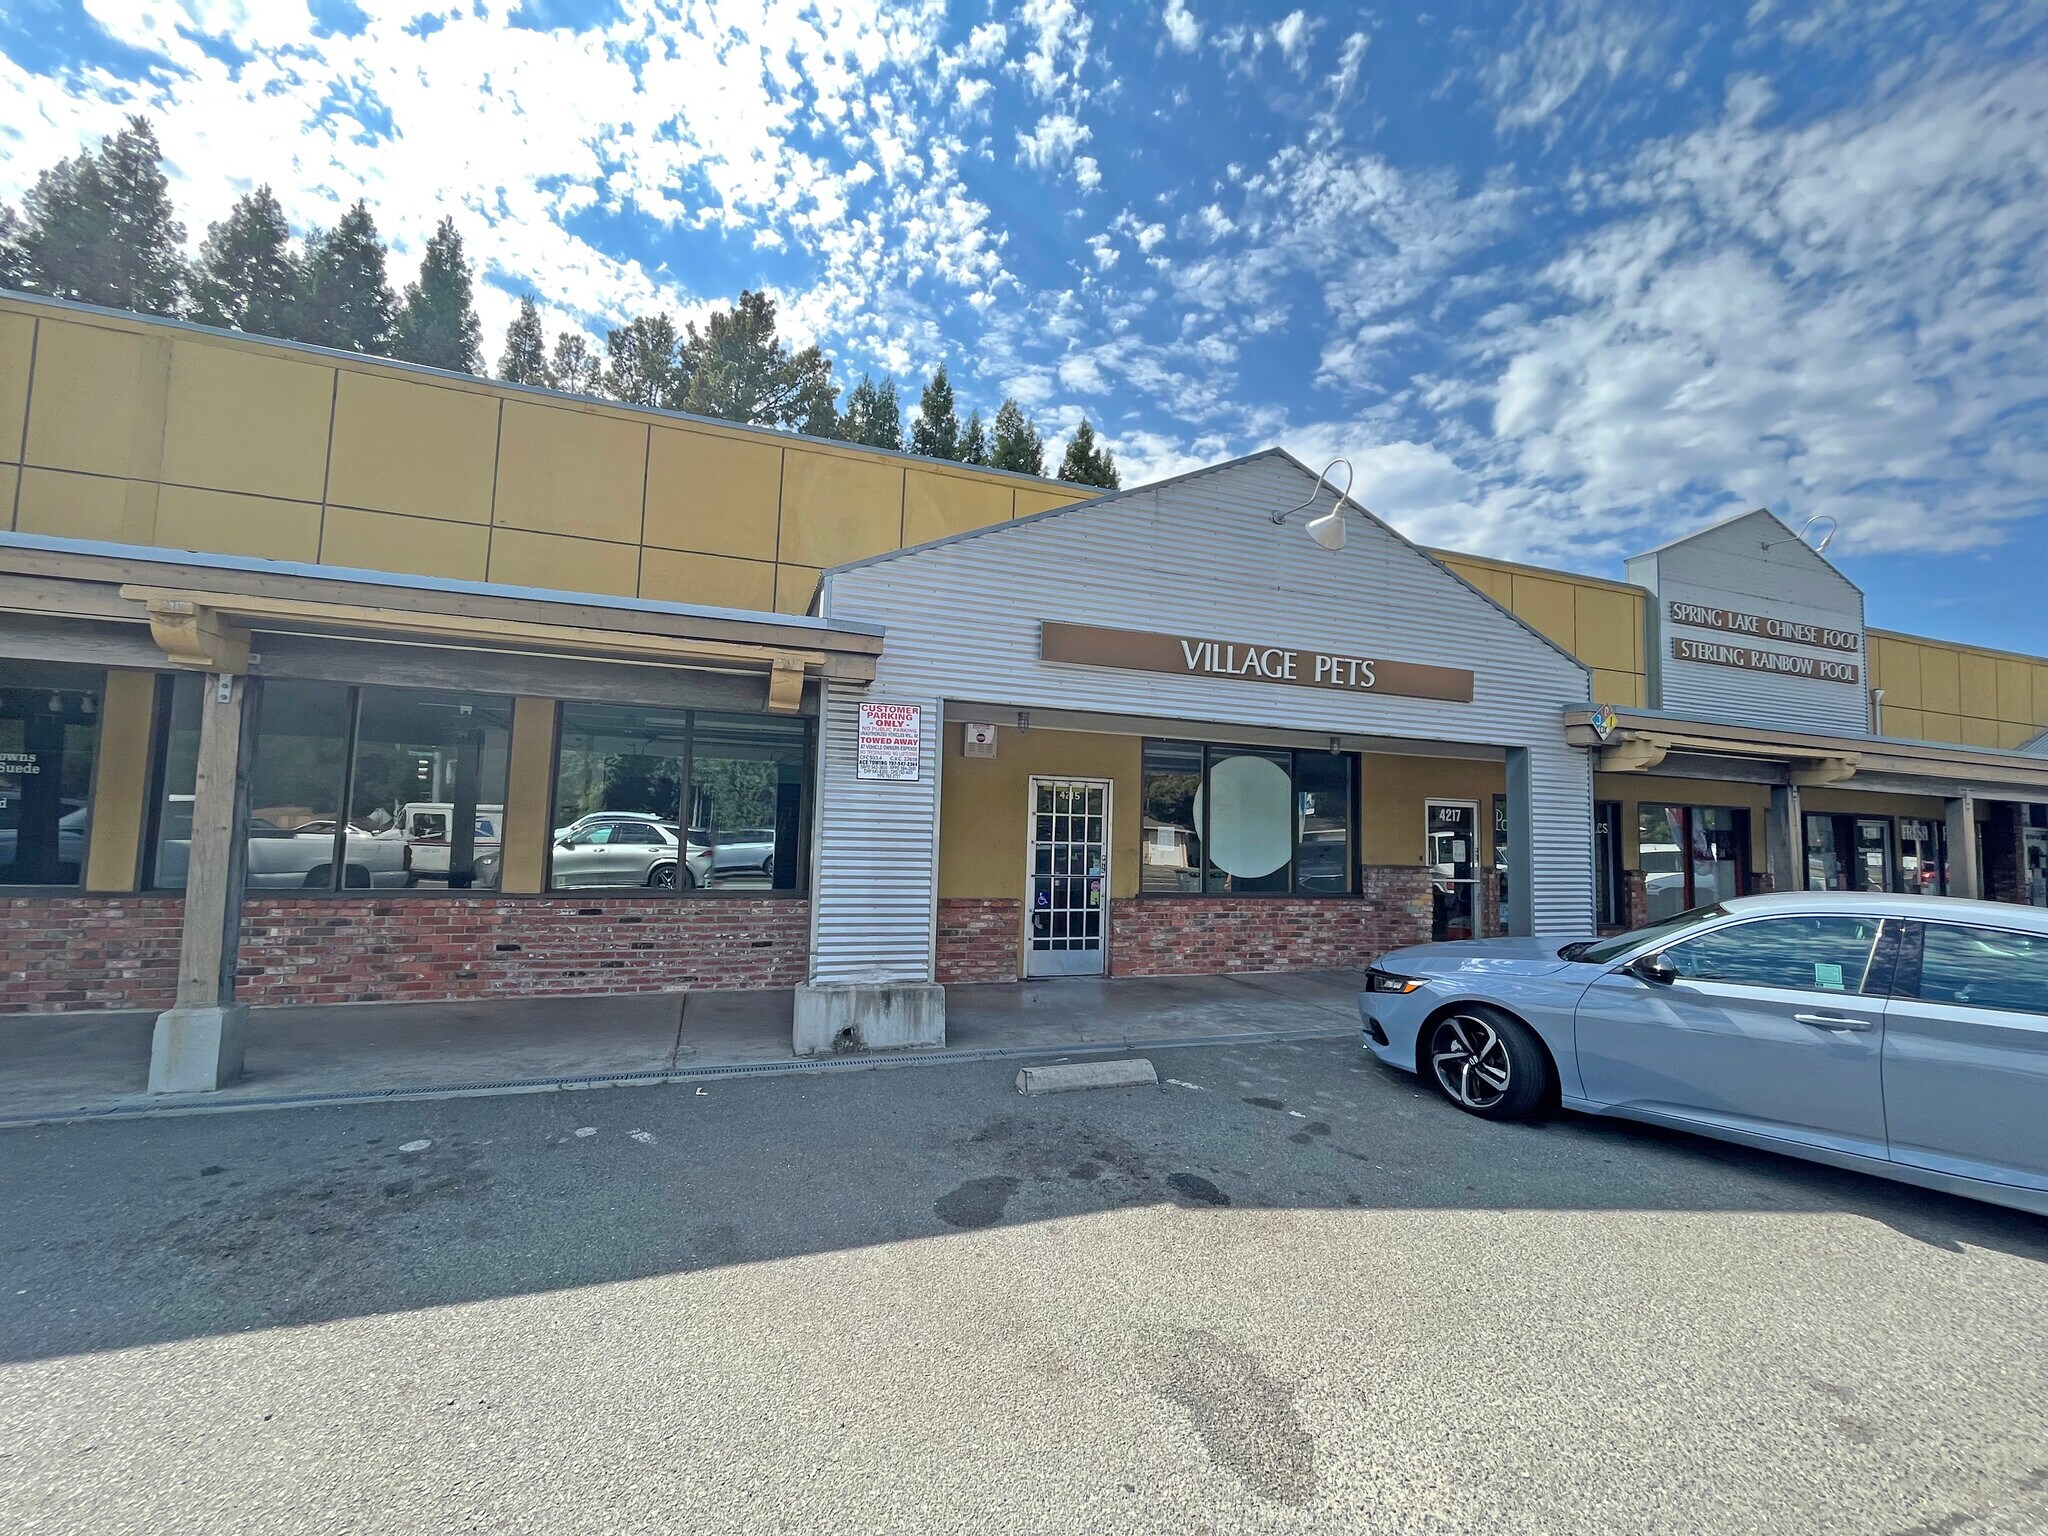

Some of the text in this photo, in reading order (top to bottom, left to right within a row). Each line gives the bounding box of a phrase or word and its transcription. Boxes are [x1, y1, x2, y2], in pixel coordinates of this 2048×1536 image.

[1673, 603, 1860, 650] SPRING LAKE CHINESE FOOD
[1180, 639, 1376, 688] VILLAGE PETS
[1681, 640, 1855, 681] STERLING RAINBOW POOL
[861, 704, 918, 714] CUSTOMER
[867, 712, 913, 721] PARKING
[875, 720, 904, 728] ONLY
[0, 762, 40, 774] Suede
[1438, 808, 1461, 822] 4217
